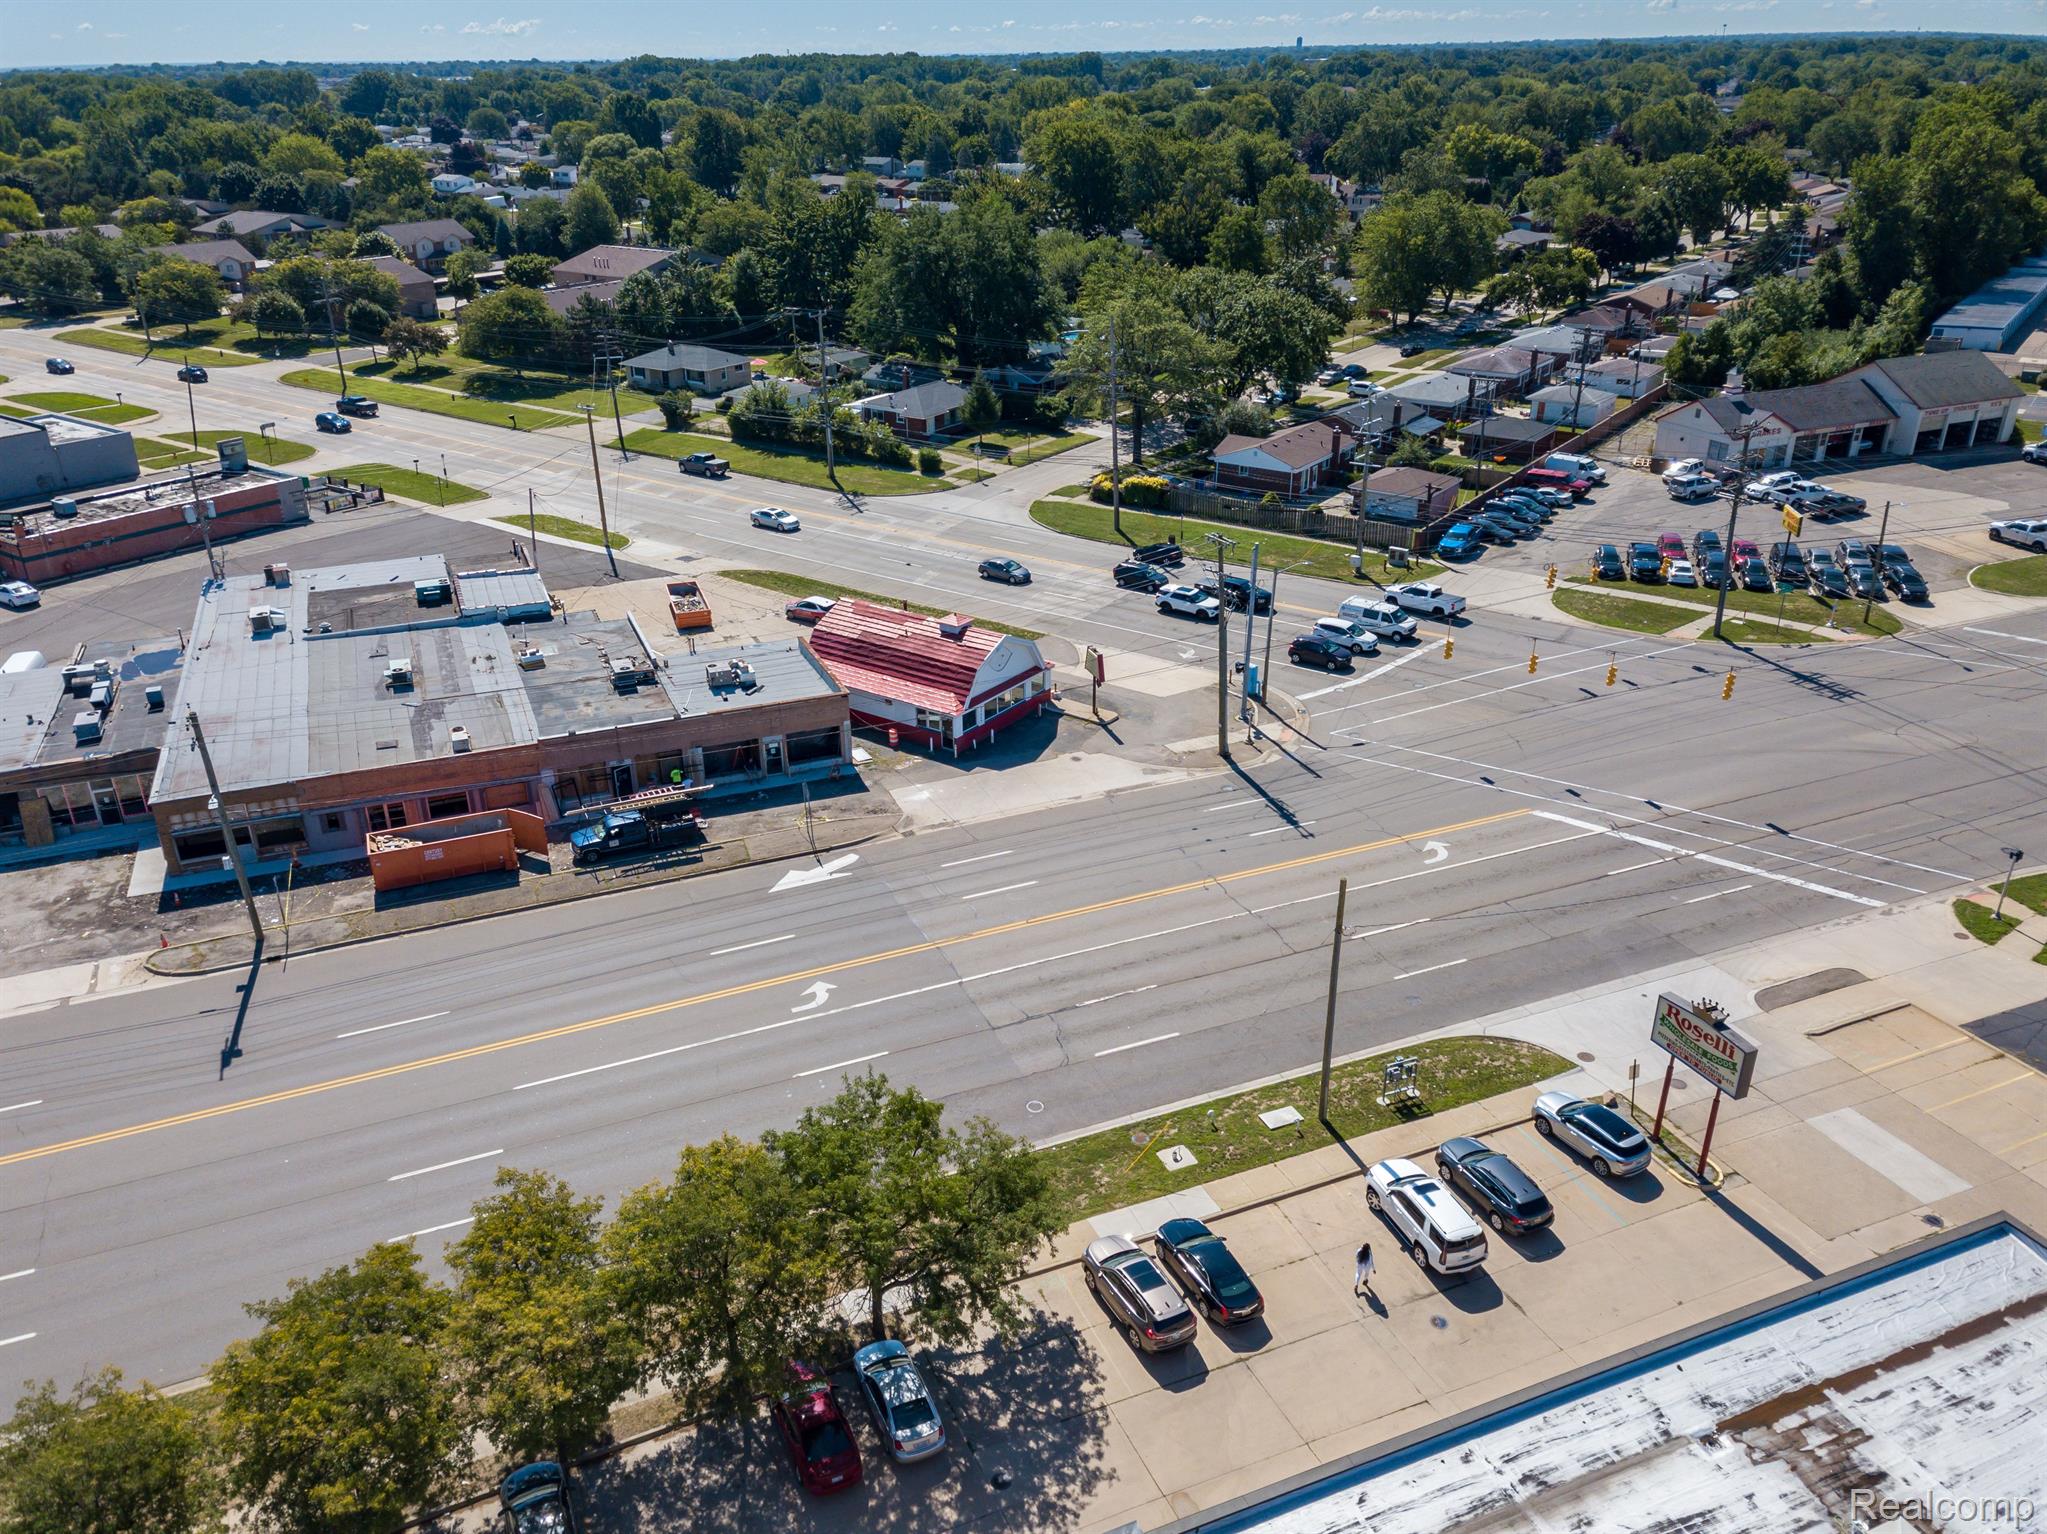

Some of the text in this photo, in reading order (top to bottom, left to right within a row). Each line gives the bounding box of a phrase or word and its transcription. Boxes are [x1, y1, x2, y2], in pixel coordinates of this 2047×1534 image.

[1663, 1017, 1733, 1068] WHOLESALE FOODS
[1666, 1003, 1736, 1061] Roselli
